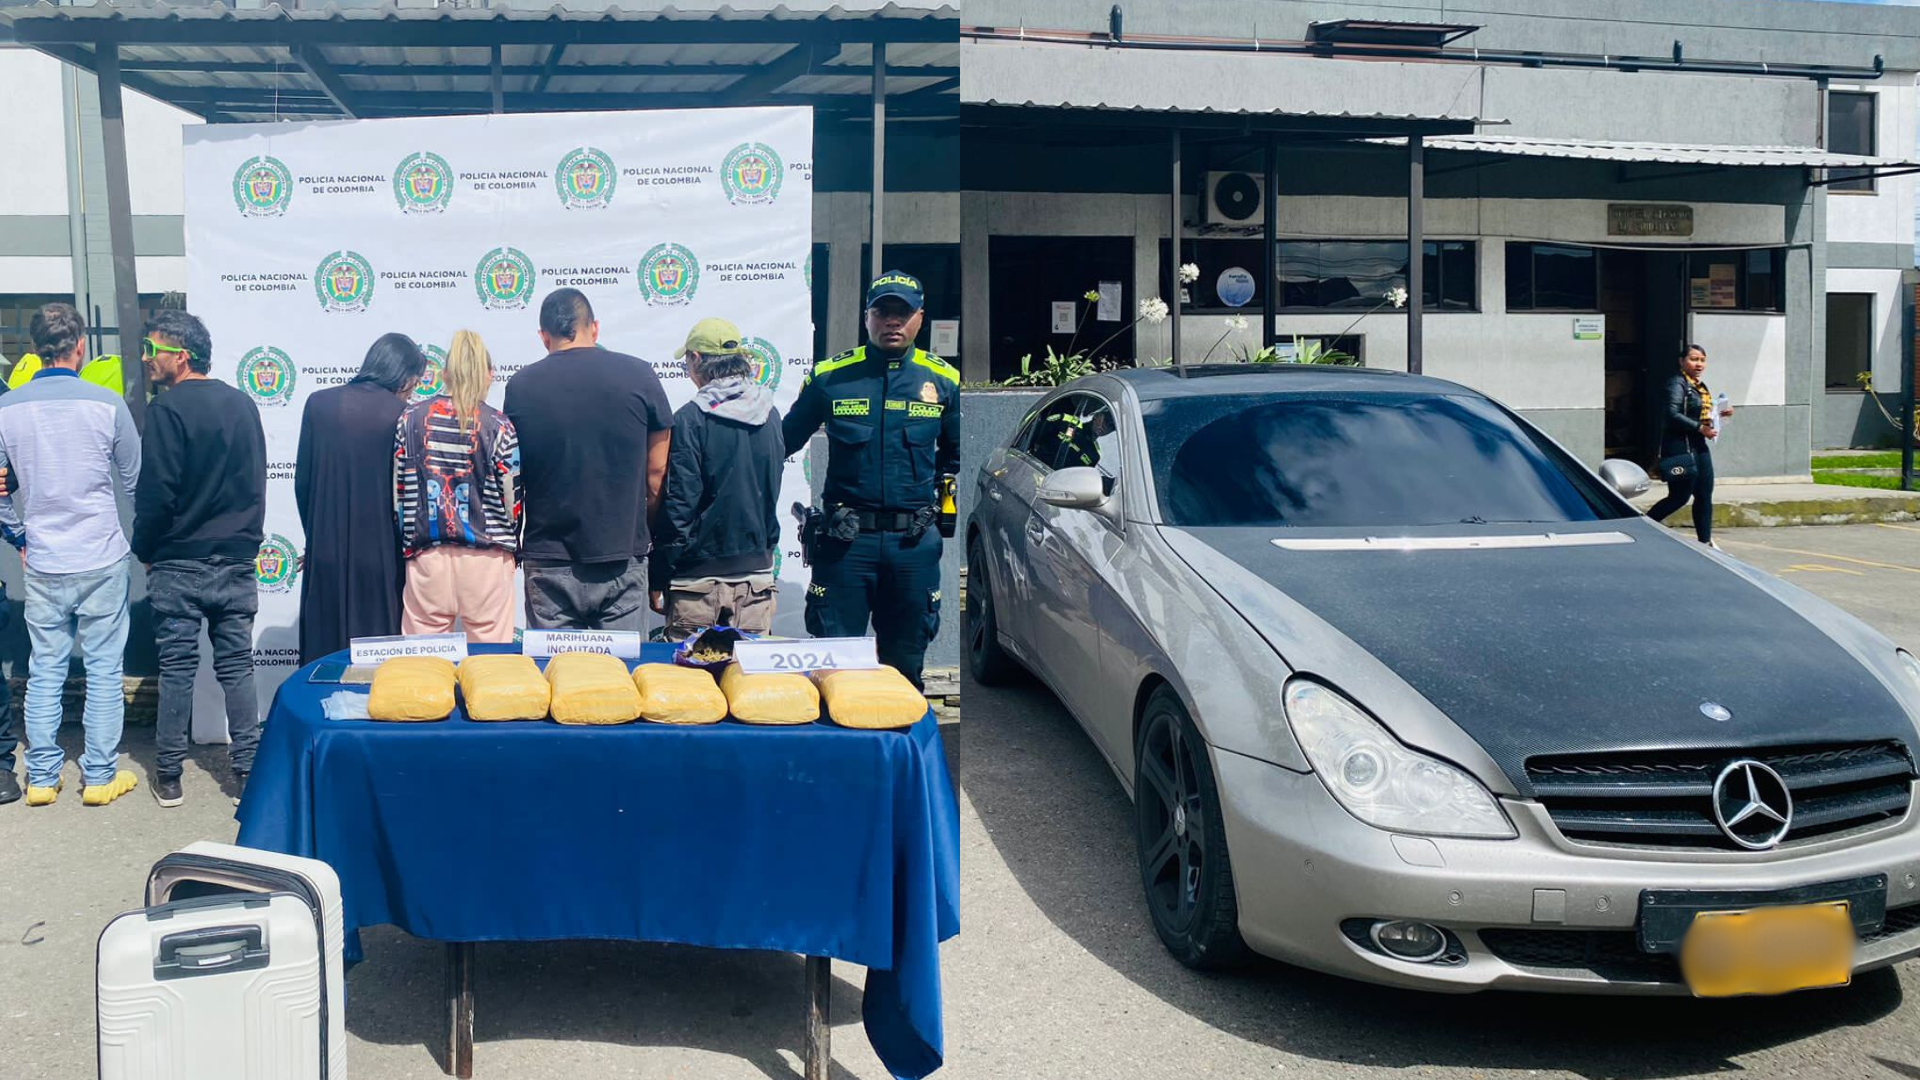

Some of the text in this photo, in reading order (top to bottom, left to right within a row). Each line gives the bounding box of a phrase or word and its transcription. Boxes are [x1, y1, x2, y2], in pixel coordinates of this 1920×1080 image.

[459, 171, 548, 180] POLICIA NACIONAL
[622, 166, 713, 176] POLICIA NACIONAL
[299, 175, 387, 184] POLICIA NACIONAL
[637, 177, 701, 186] DE COLOMBIA
[312, 185, 375, 194] DE COLOMBIA
[473, 181, 537, 190] DE COLOMBIA
[541, 266, 630, 276] POLICIA NACIONAL
[706, 262, 797, 272] POLICIA NACIONAL
[220, 273, 308, 282] POLICIA NACIONAL
[380, 270, 468, 279] POLICIA NACIONAL
[719, 273, 785, 282] DE COLOMBIA
[394, 280, 456, 290] DE COLOMBIA
[555, 277, 619, 286] DE COLOMBIA
[234, 283, 297, 292] DE COLOMBIA
[302, 366, 338, 374] POLICIA
[316, 377, 328, 385] DE
[546, 633, 614, 643] MARIHUANA
[405, 646, 418, 655] DE
[770, 652, 838, 669] 2024
